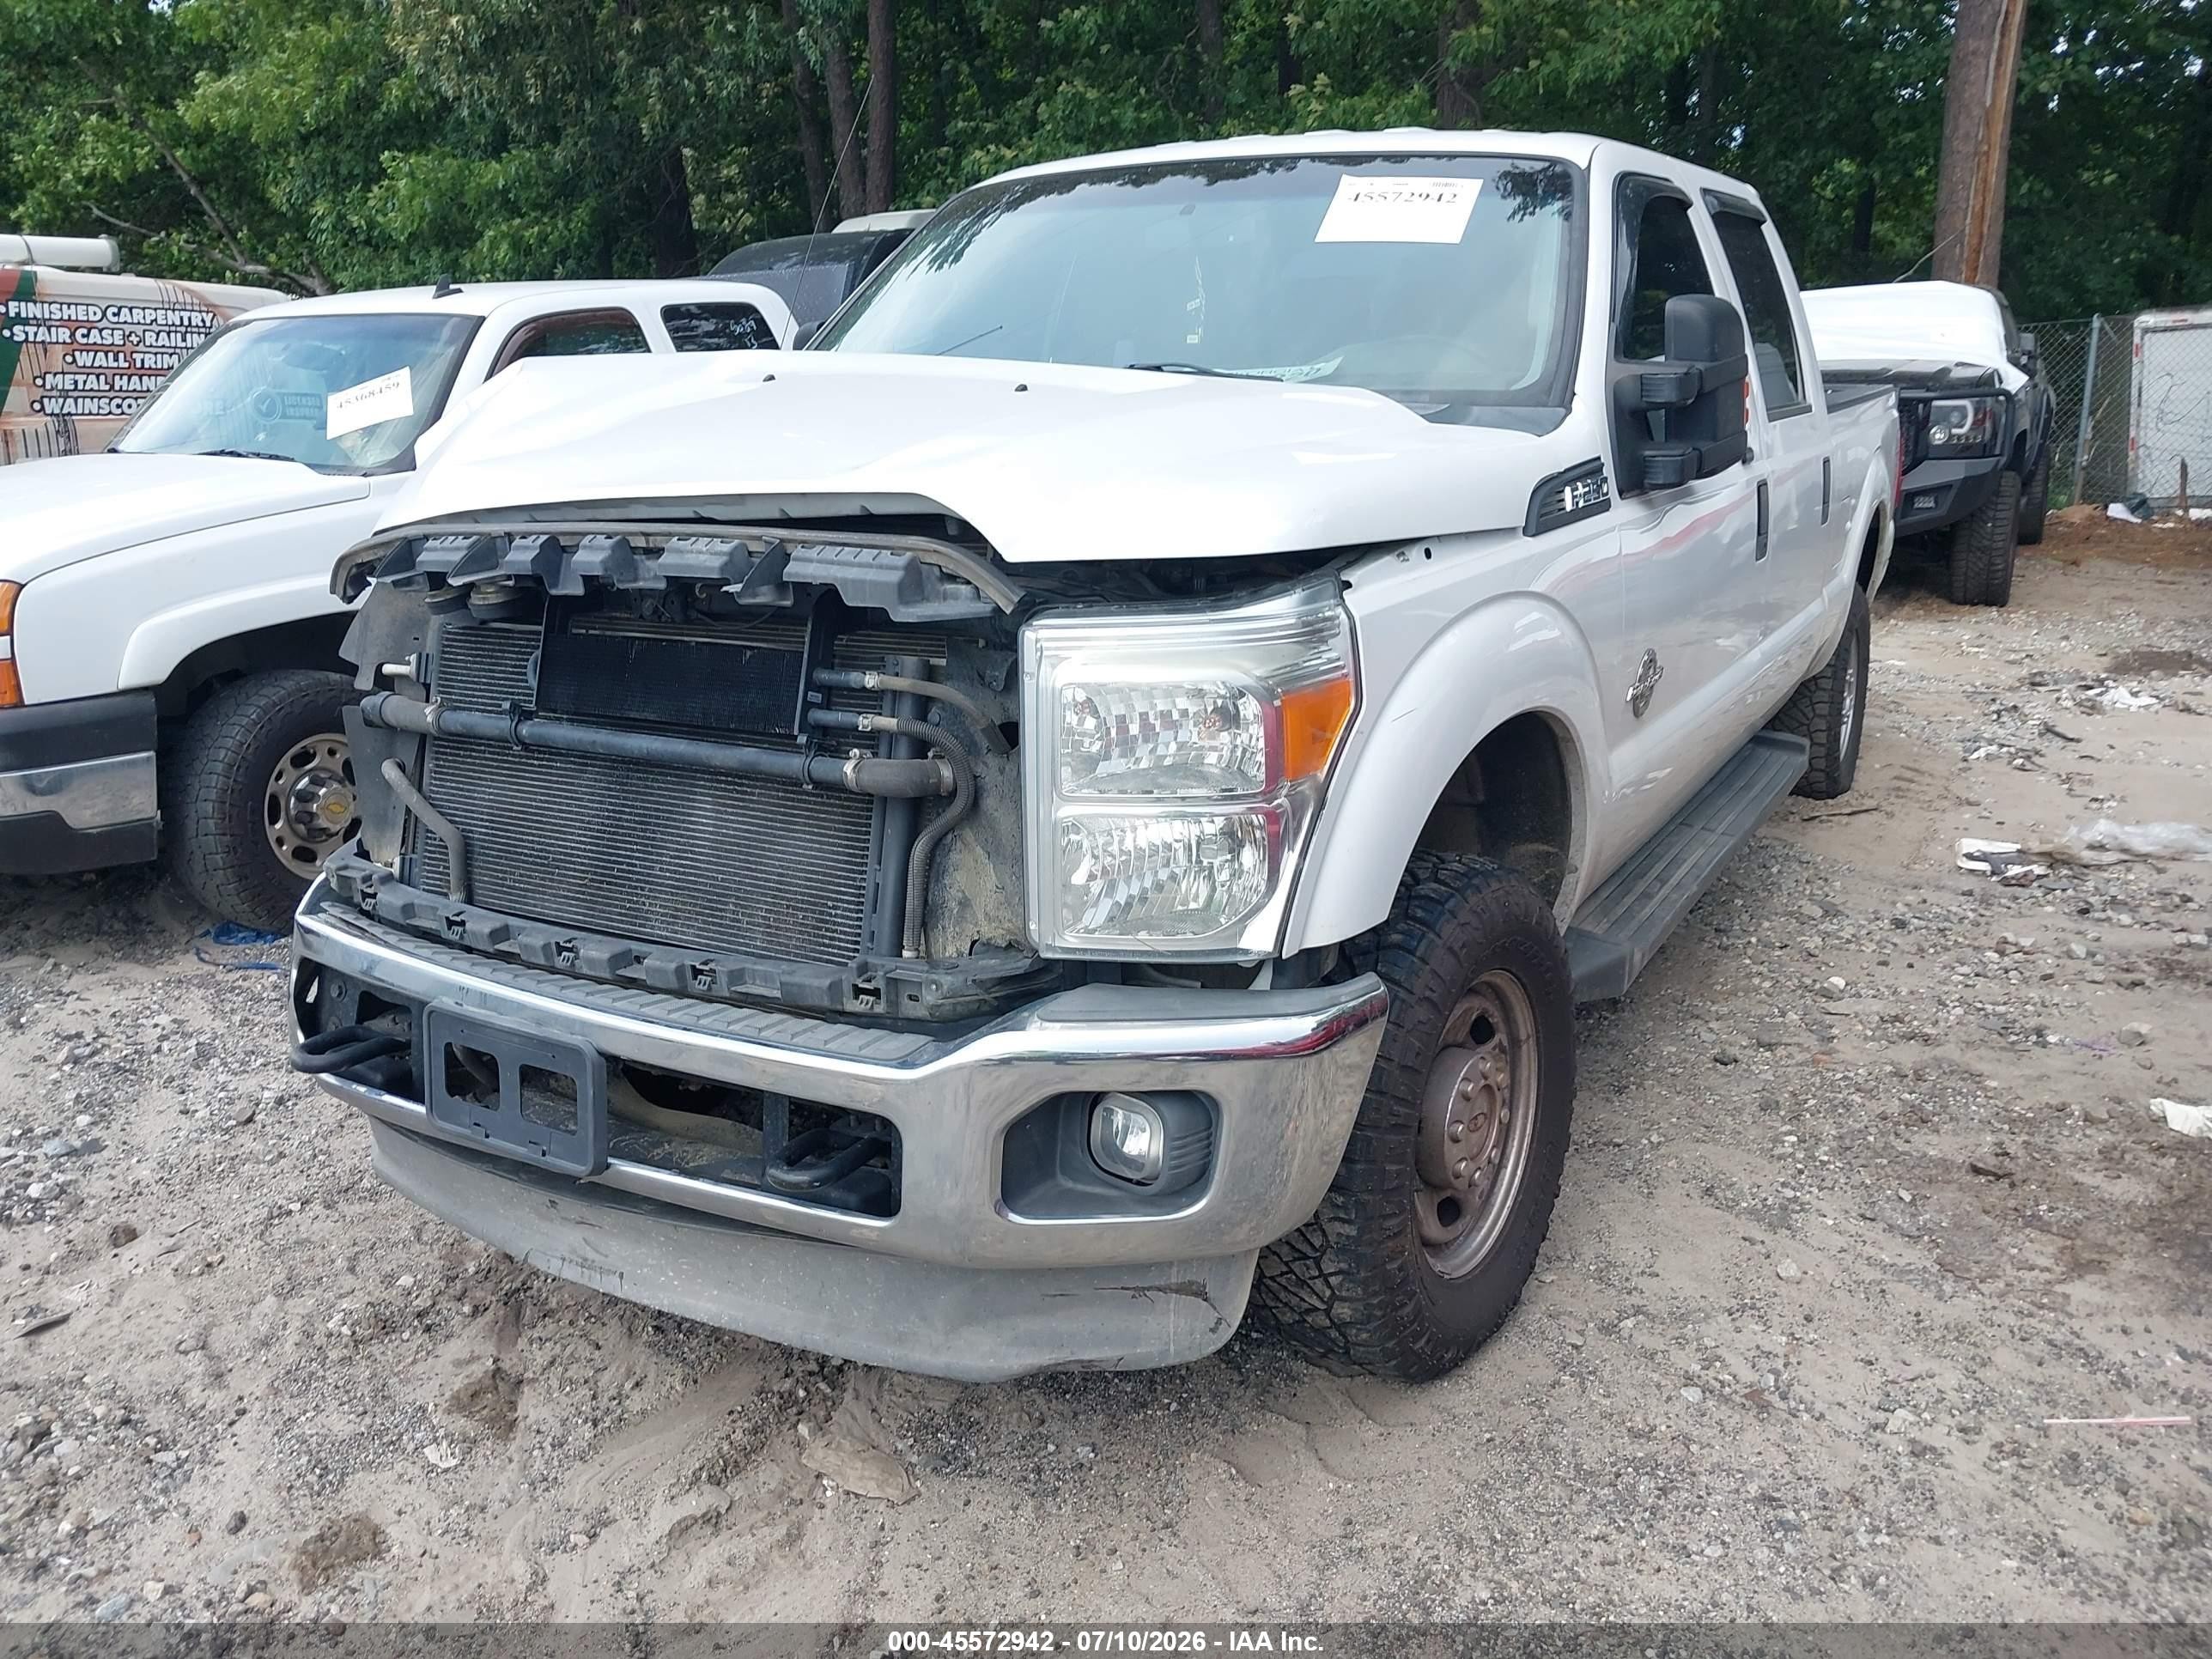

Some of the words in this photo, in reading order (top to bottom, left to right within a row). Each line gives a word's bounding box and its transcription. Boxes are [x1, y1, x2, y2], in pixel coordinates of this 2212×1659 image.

[1347, 191, 1458, 204] 45572942
[8, 301, 103, 322] FINISHED
[106, 306, 214, 327] CARPENTRY
[12, 325, 72, 343] STAIR
[75, 327, 125, 345] CASE
[74, 350, 130, 368] WALL
[132, 353, 179, 369] TRIM
[45, 374, 110, 390] METAL
